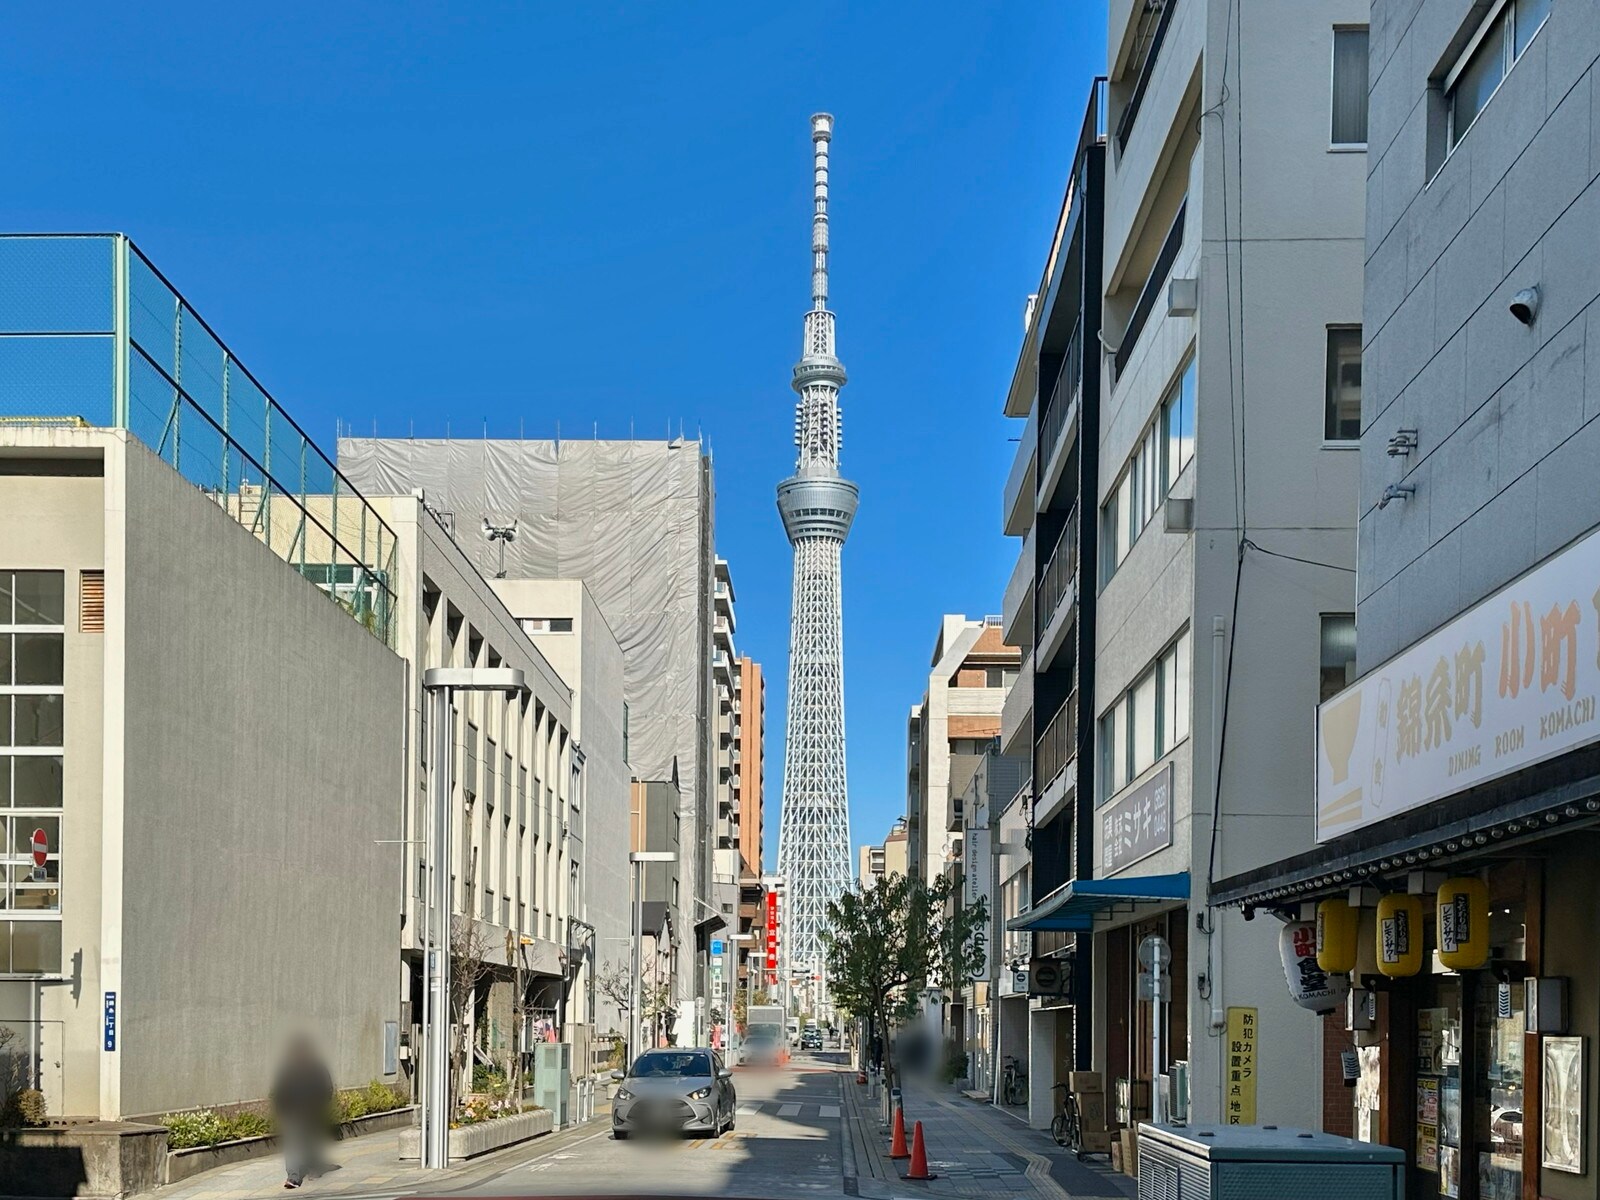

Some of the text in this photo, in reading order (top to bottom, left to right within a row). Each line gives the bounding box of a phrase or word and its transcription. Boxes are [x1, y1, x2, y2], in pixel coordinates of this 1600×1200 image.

[1448, 695, 1595, 776] DINING ROOM KOMACHI
[1124, 796, 1152, 848] ミサキ
[1384, 921, 1394, 960] レモンサワー
[1443, 906, 1454, 950] レモンサワー
[1299, 989, 1336, 1000] KOMACHI
[1243, 1014, 1254, 1078] 防犯カメラ
[1230, 1041, 1242, 1125] 設置重点地区
